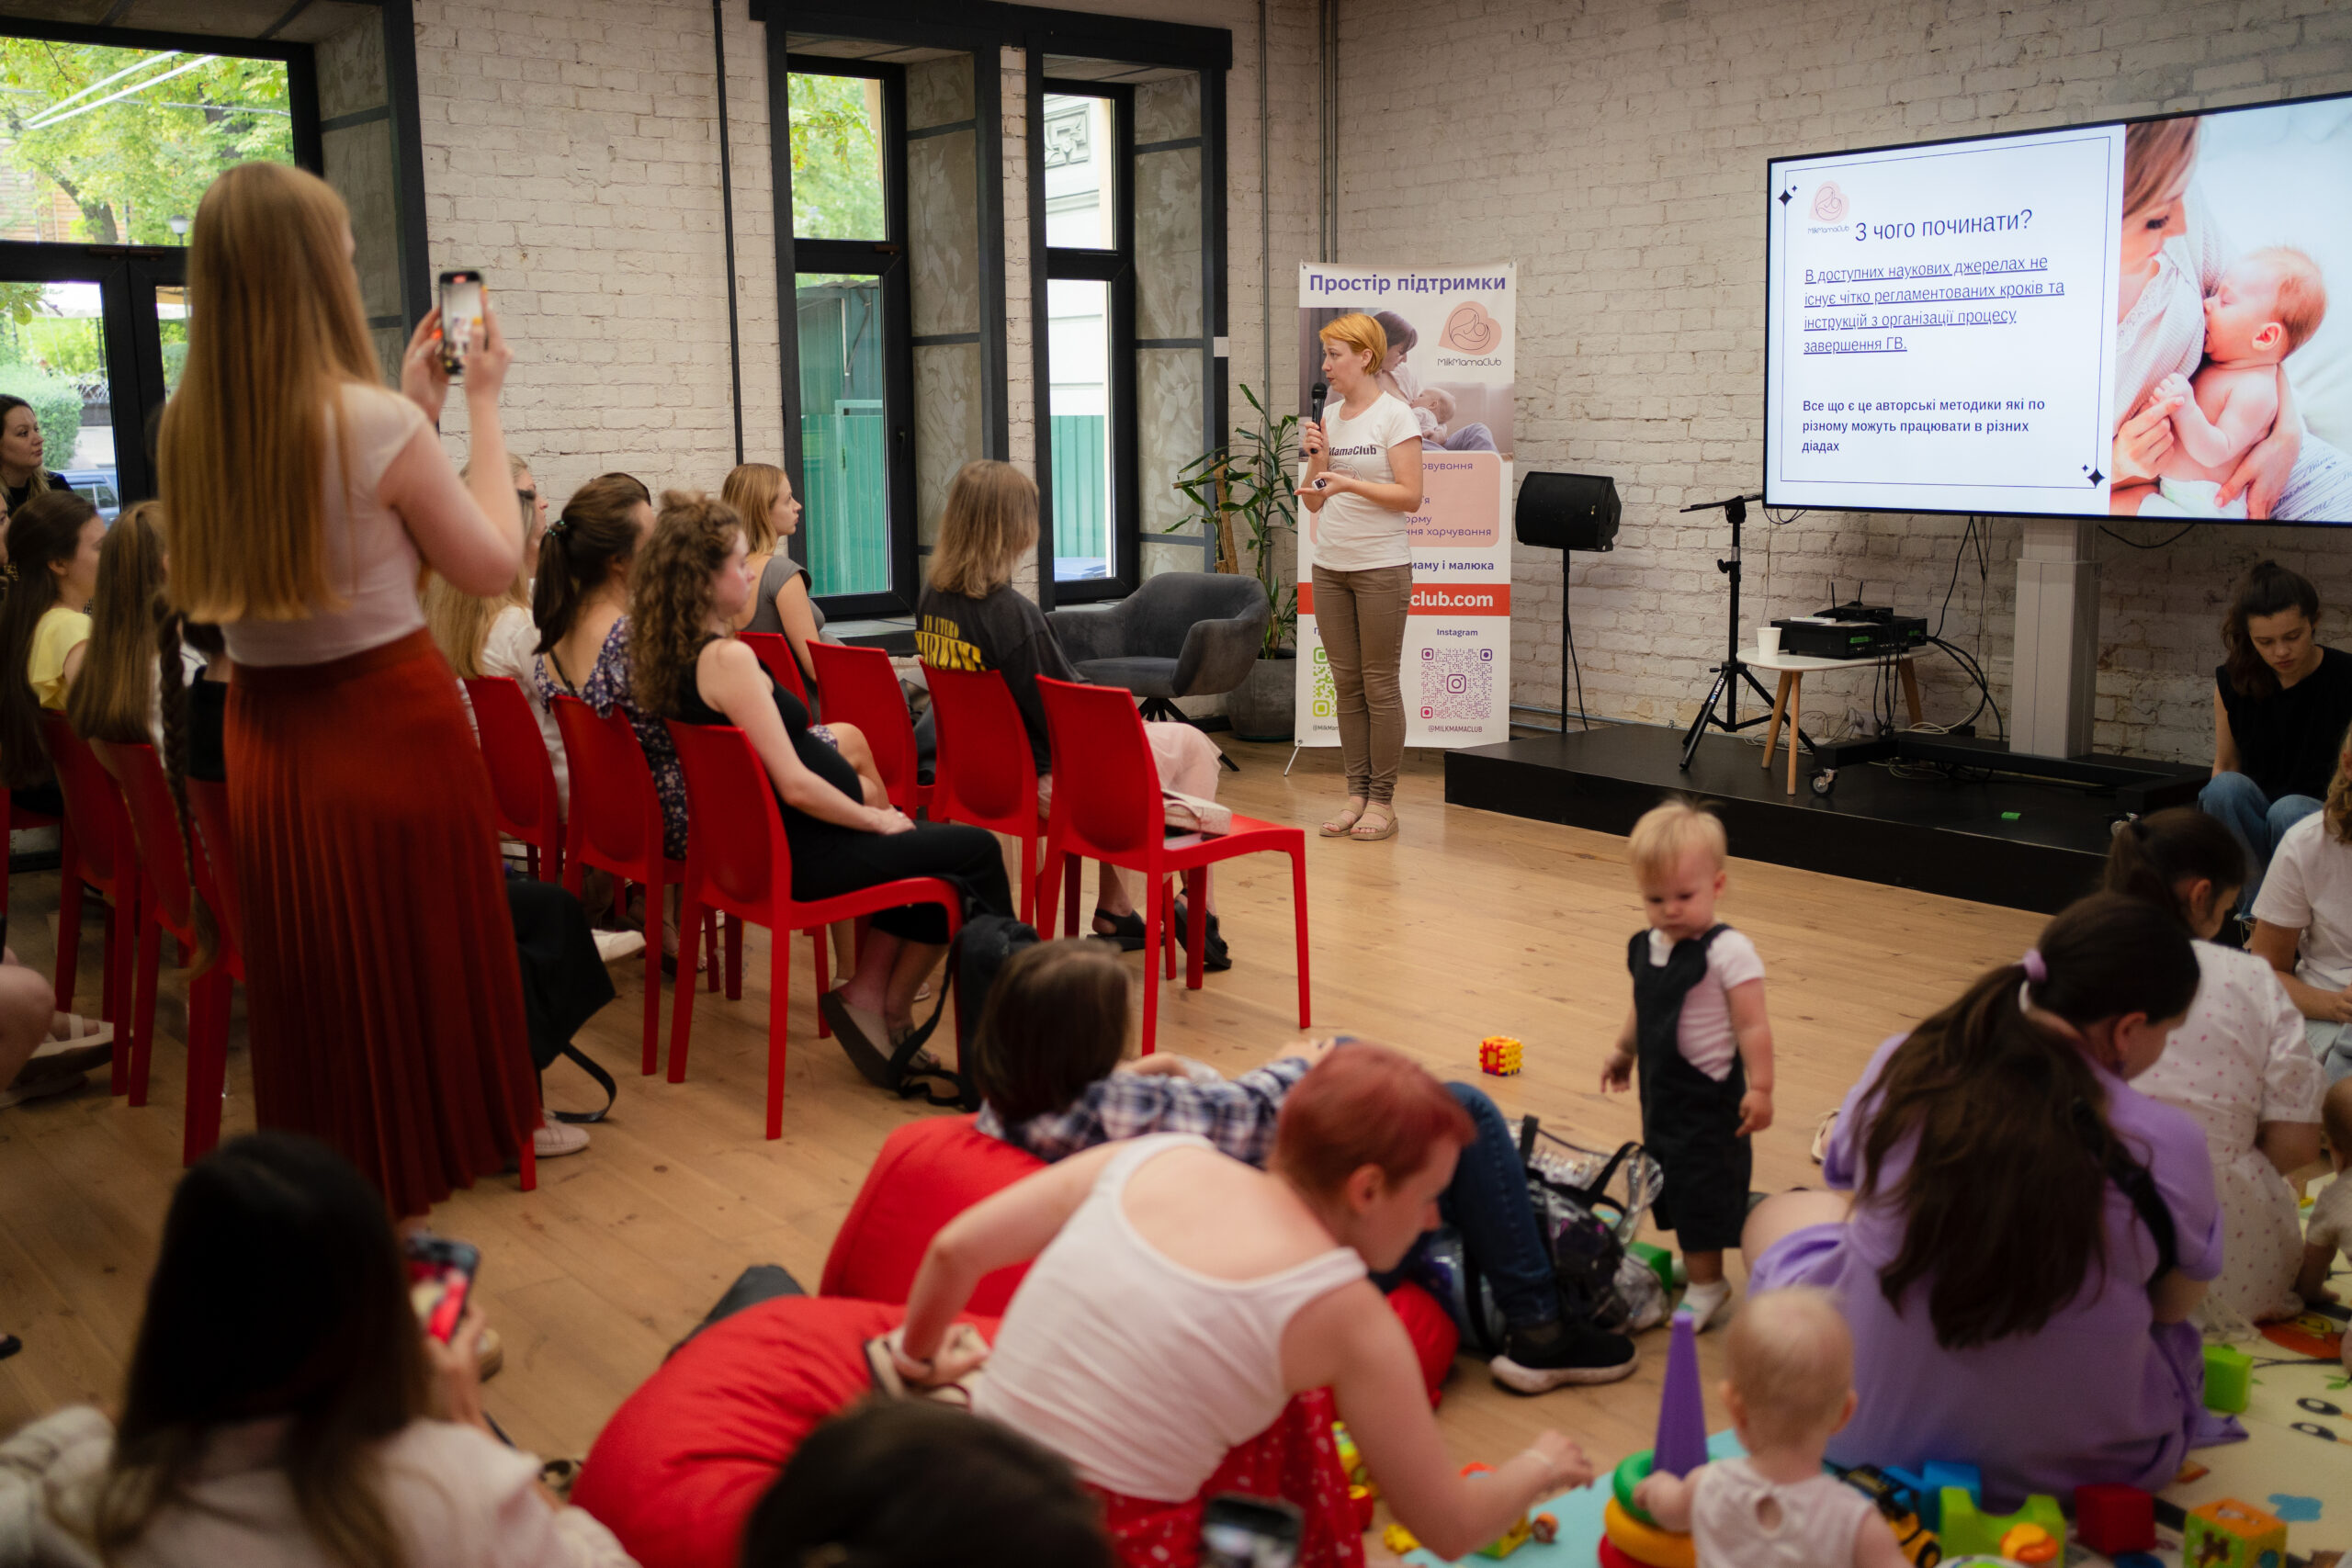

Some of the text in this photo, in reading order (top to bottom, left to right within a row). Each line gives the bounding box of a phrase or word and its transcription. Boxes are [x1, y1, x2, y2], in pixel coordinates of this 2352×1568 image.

[1855, 209, 2033, 242] З чого починати?
[1805, 256, 2048, 284] В доступних наукових джерелах не
[1309, 274, 1506, 295] Простір підтримки
[1804, 280, 2064, 307] існує чітко регламентованих кроків та
[1804, 309, 2018, 331] інструкцій з організації процесу
[1804, 336, 1907, 355] завершення ГВ.
[1437, 357, 1502, 367] MilkMamaClub
[1803, 398, 2045, 414] Все що є це авторські методики які по
[1803, 419, 2030, 434] різному можуть працювати в різних
[1802, 439, 1839, 454] діадах
[1427, 527, 1492, 537] харчування
[1442, 560, 1446, 570] і
[1449, 561, 1495, 570] малюка
[1437, 628, 1478, 637] Instagram
[1428, 725, 1483, 733] @MILKMAMACLUB
